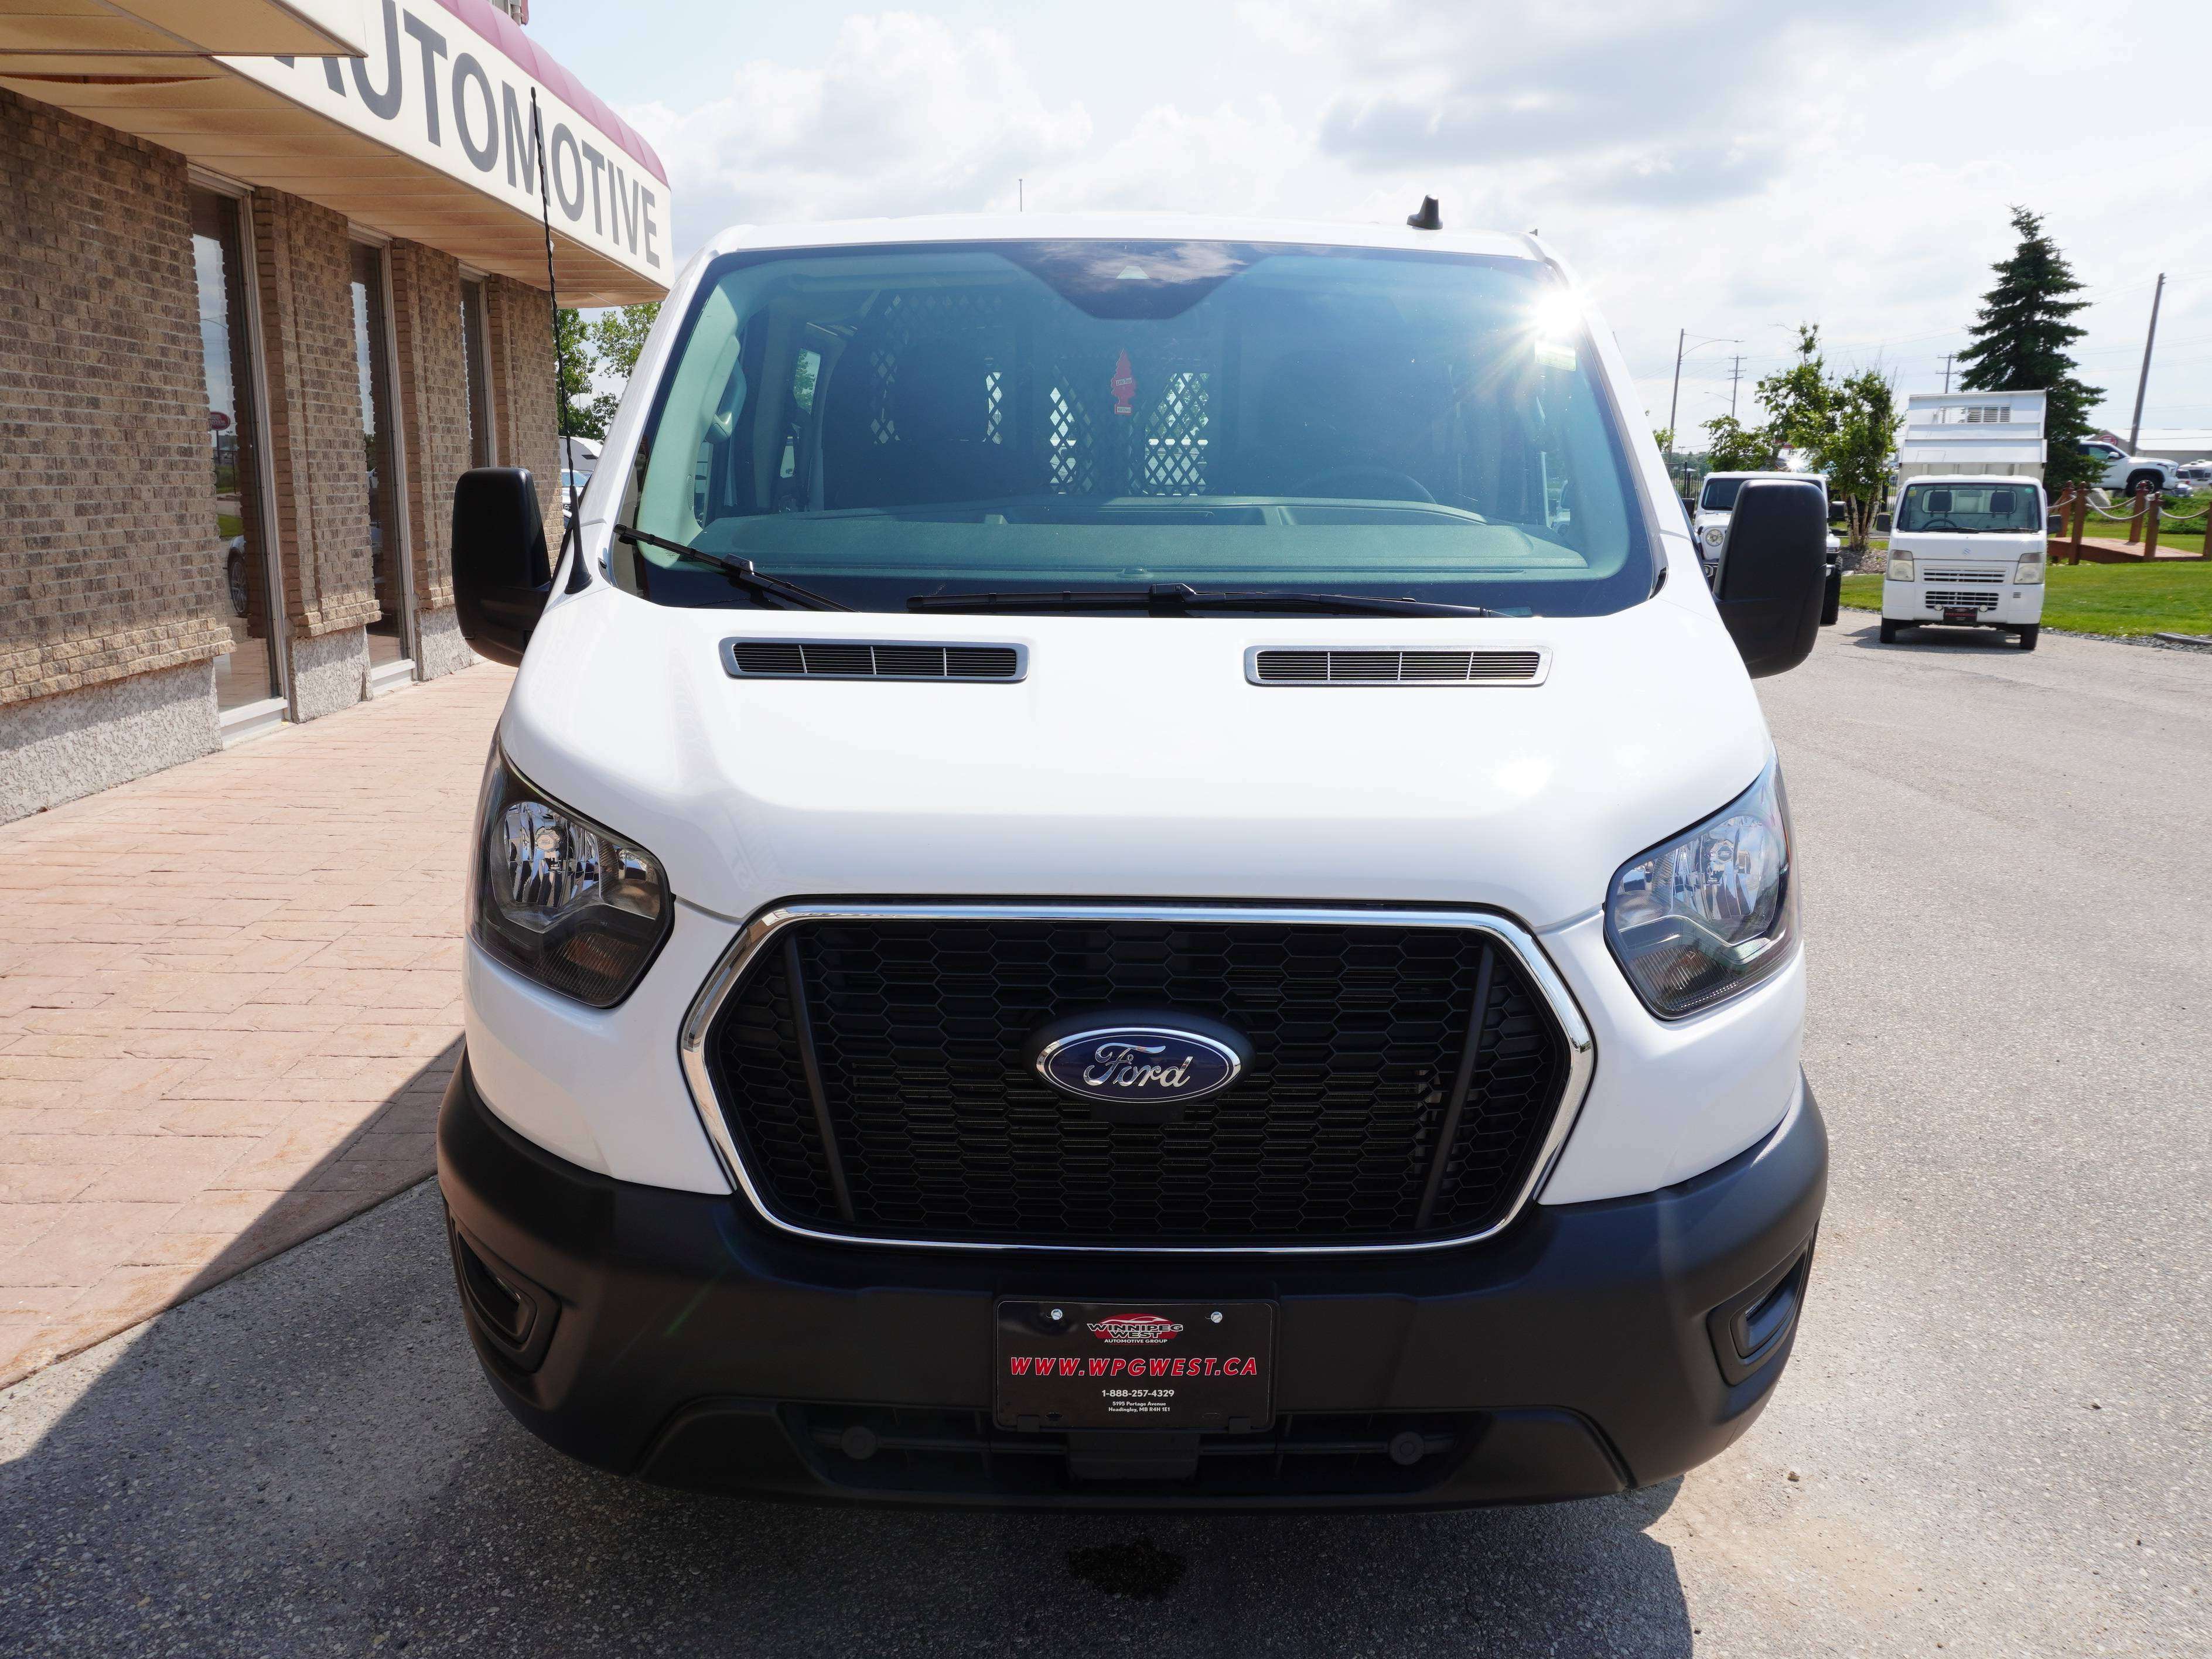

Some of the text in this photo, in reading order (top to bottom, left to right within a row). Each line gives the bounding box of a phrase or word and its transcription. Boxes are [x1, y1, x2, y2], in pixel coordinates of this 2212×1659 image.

[274, 0, 661, 269] UTOMOTIVE
[1083, 1043, 1193, 1087] Ford
[1087, 1323, 1183, 1332] WINNIPEG
[1011, 1357, 1257, 1377] WWW.WPGWEST.CA
